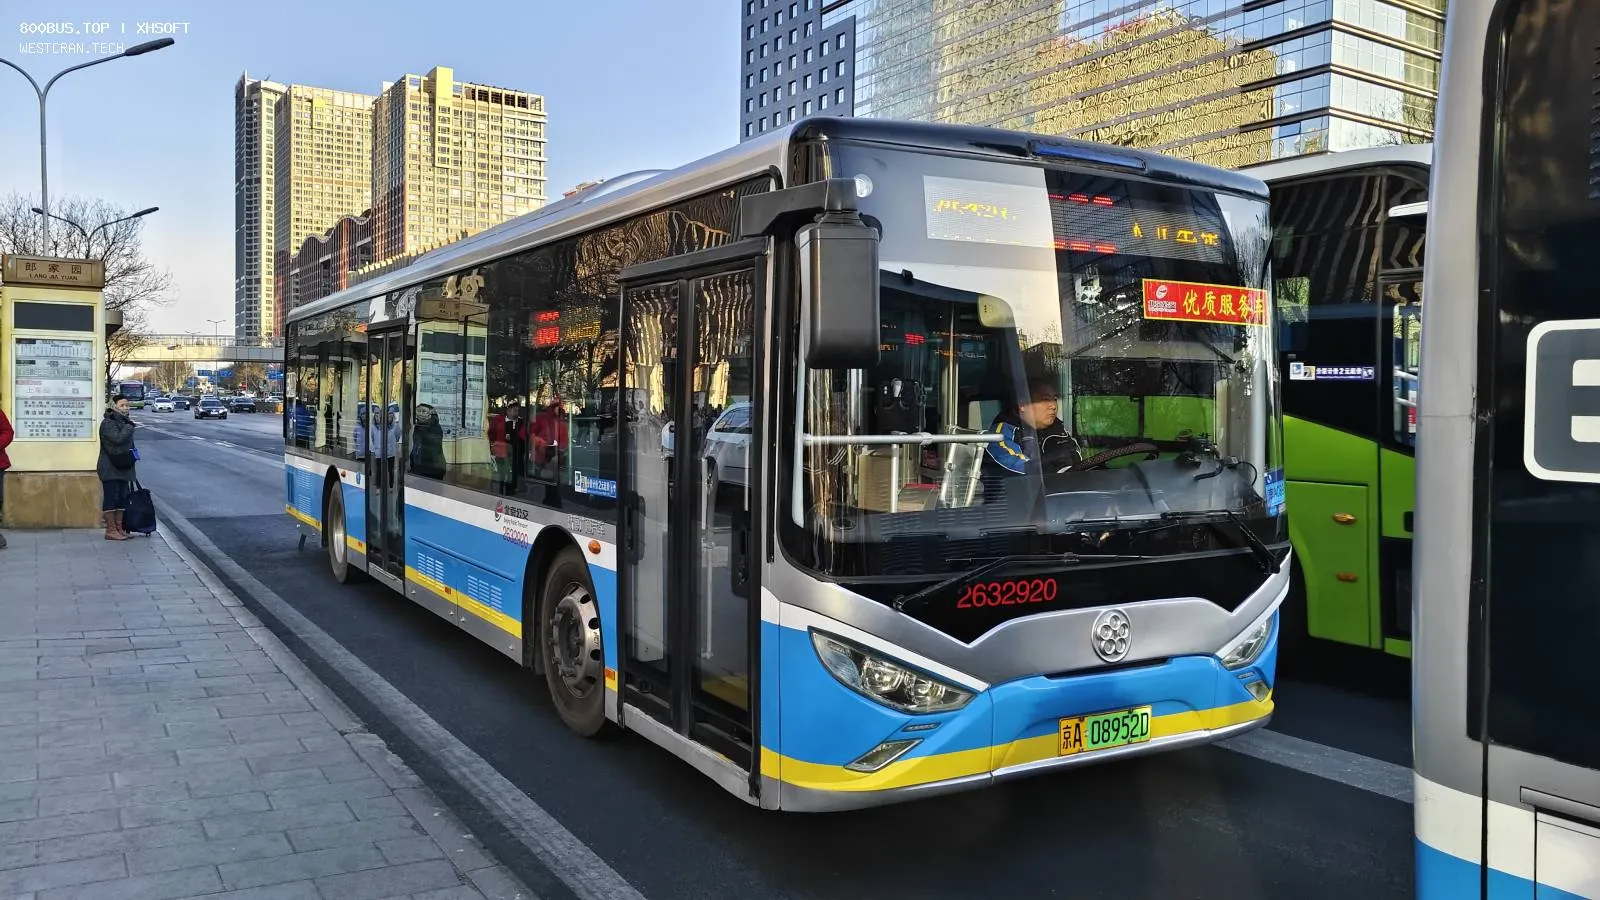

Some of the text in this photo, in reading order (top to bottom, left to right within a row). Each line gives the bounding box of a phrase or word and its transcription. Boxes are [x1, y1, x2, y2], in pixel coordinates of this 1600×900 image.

[25, 262, 82, 275] 郎家园
[957, 578, 1057, 609] 2632920
[1062, 712, 1149, 749] 京A 08952D
